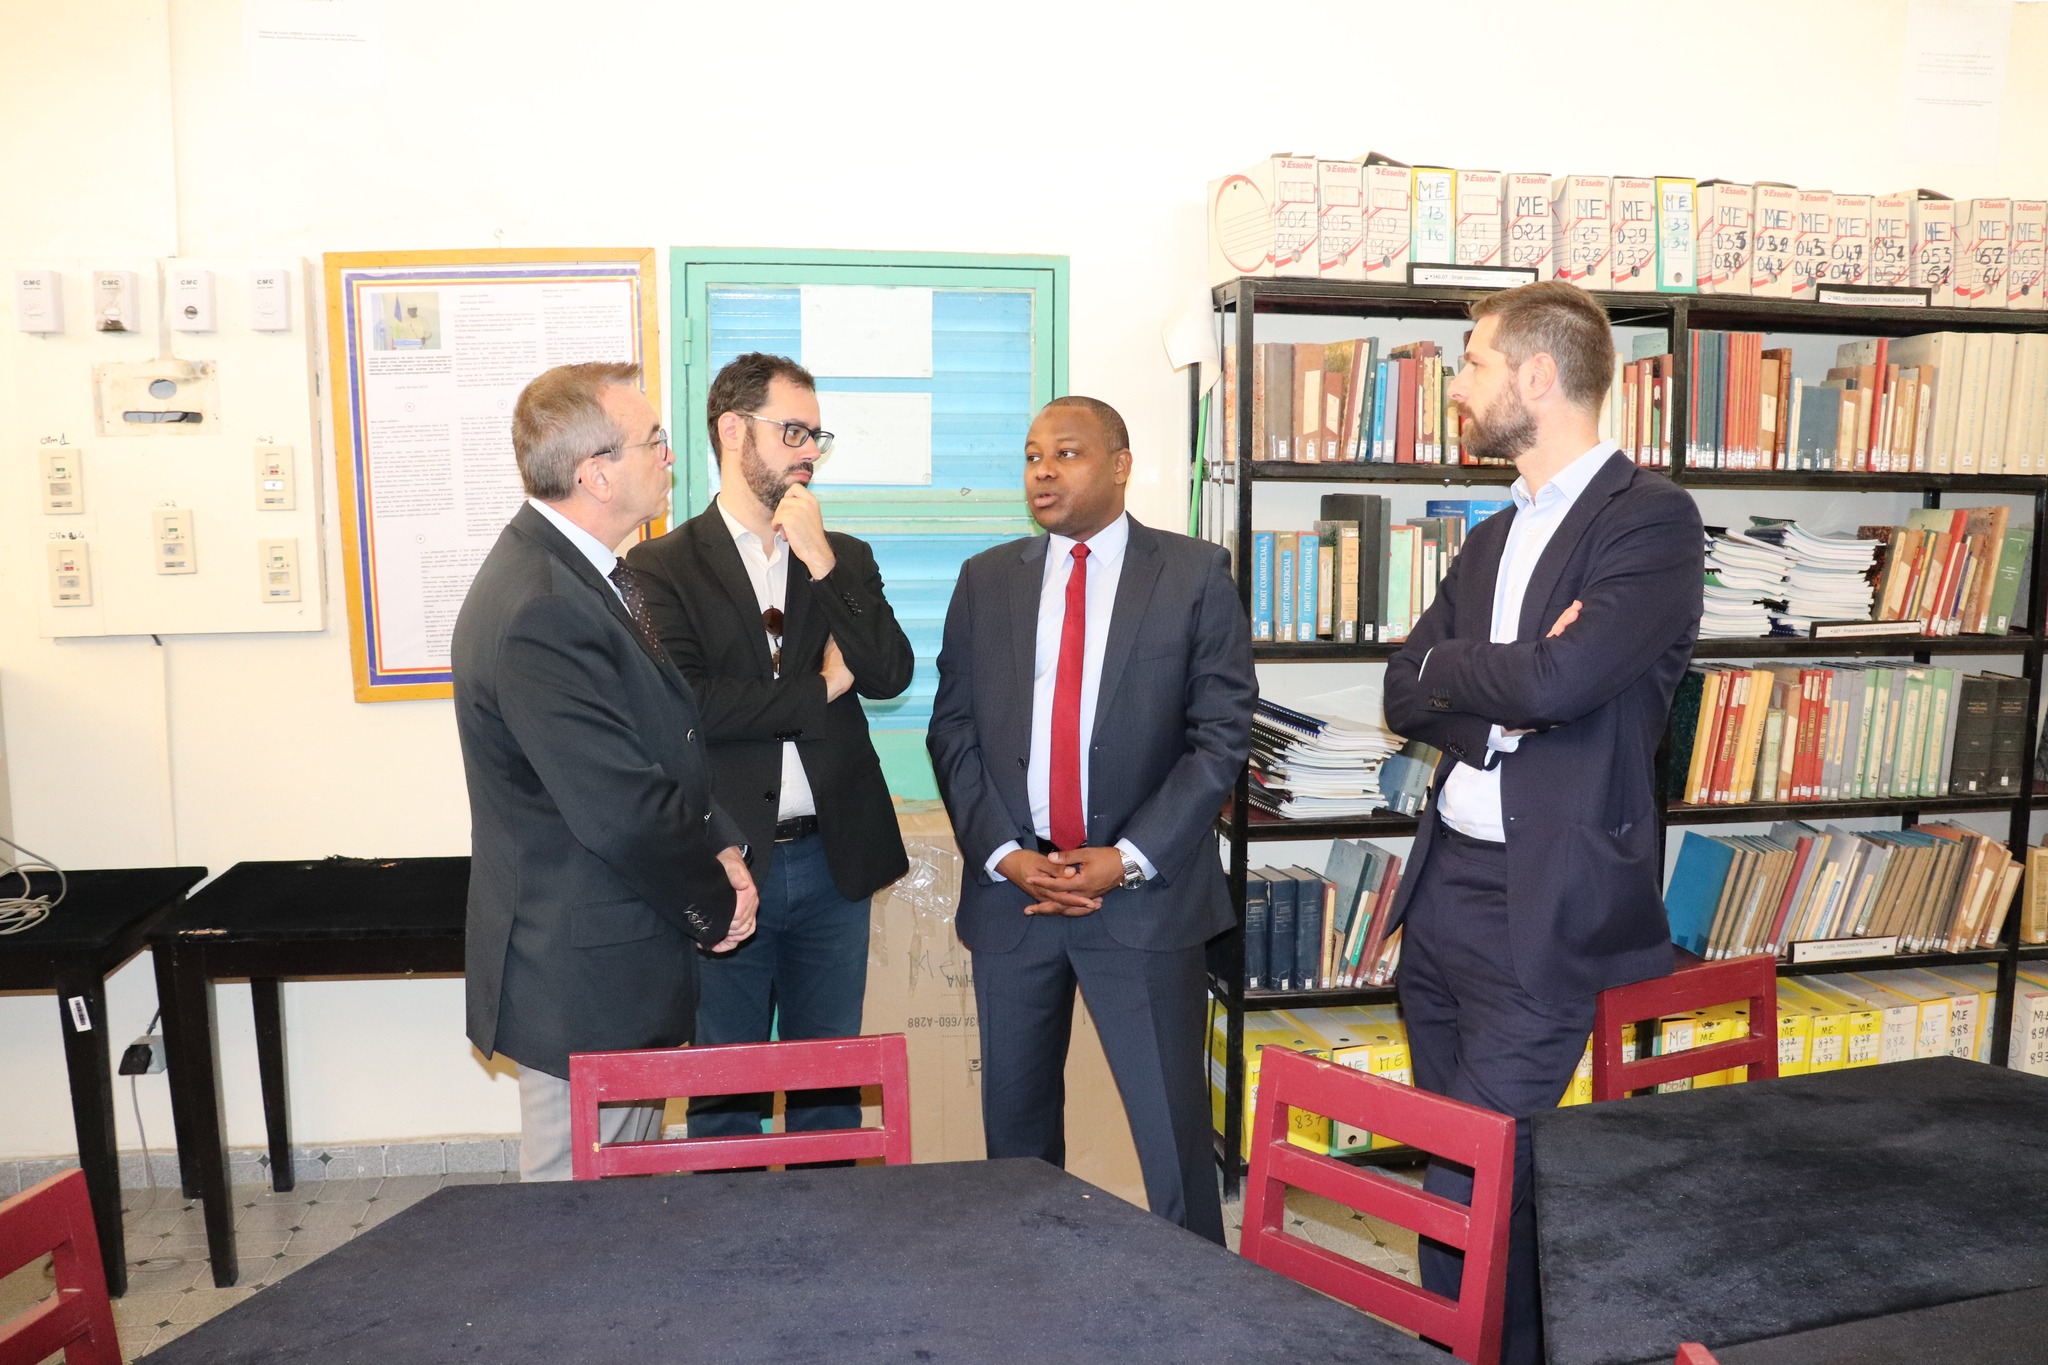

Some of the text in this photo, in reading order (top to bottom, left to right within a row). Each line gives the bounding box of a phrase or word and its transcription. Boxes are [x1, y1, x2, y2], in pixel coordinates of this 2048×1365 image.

[1286, 160, 1313, 169] Esselte
[1331, 165, 1358, 174] Esselte
[1380, 169, 1406, 177] Esselte
[1469, 174, 1497, 183] Esselte
[1521, 175, 1547, 184] Esselte
[1418, 180, 1445, 200] ME
[1580, 179, 1604, 187] Esselte
[1626, 180, 1650, 189] Esselte
[1725, 187, 1748, 195] Esselte
[1664, 194, 1688, 210] ME
[1768, 190, 1792, 198] Esselte
[1805, 193, 1828, 202] Esselte
[1841, 198, 1866, 206] Esselte
[1516, 196, 1544, 217] ME
[1576, 199, 1602, 219] ME
[1621, 201, 1644, 220] ME
[1883, 200, 1904, 208] Esselte
[1983, 201, 2006, 209] Esselte
[2022, 203, 2042, 211] Esselte
[1278, 210, 1308, 228] 001
[1321, 214, 1353, 231] 005
[1721, 206, 1743, 226] ME
[1765, 209, 1788, 229] ME
[1801, 213, 1824, 232] ME
[1511, 223, 1546, 241] 021
[1836, 218, 1863, 237] ME
[1878, 218, 1902, 238] ME
[1925, 222, 1946, 243] ME
[1979, 220, 2002, 240] ME
[2017, 222, 2040, 241] ME
[1921, 247, 1952, 264] 053
[2013, 248, 2040, 265] 065
[1304, 547, 1312, 591] COMMERCIAL
[1283, 556, 1291, 601] COMMERCIAL
[946, 974, 974, 988] HINA
[1700, 1033, 1715, 1042] ME
[1949, 1024, 1968, 1036] 888
[1669, 1031, 1690, 1047] ME
